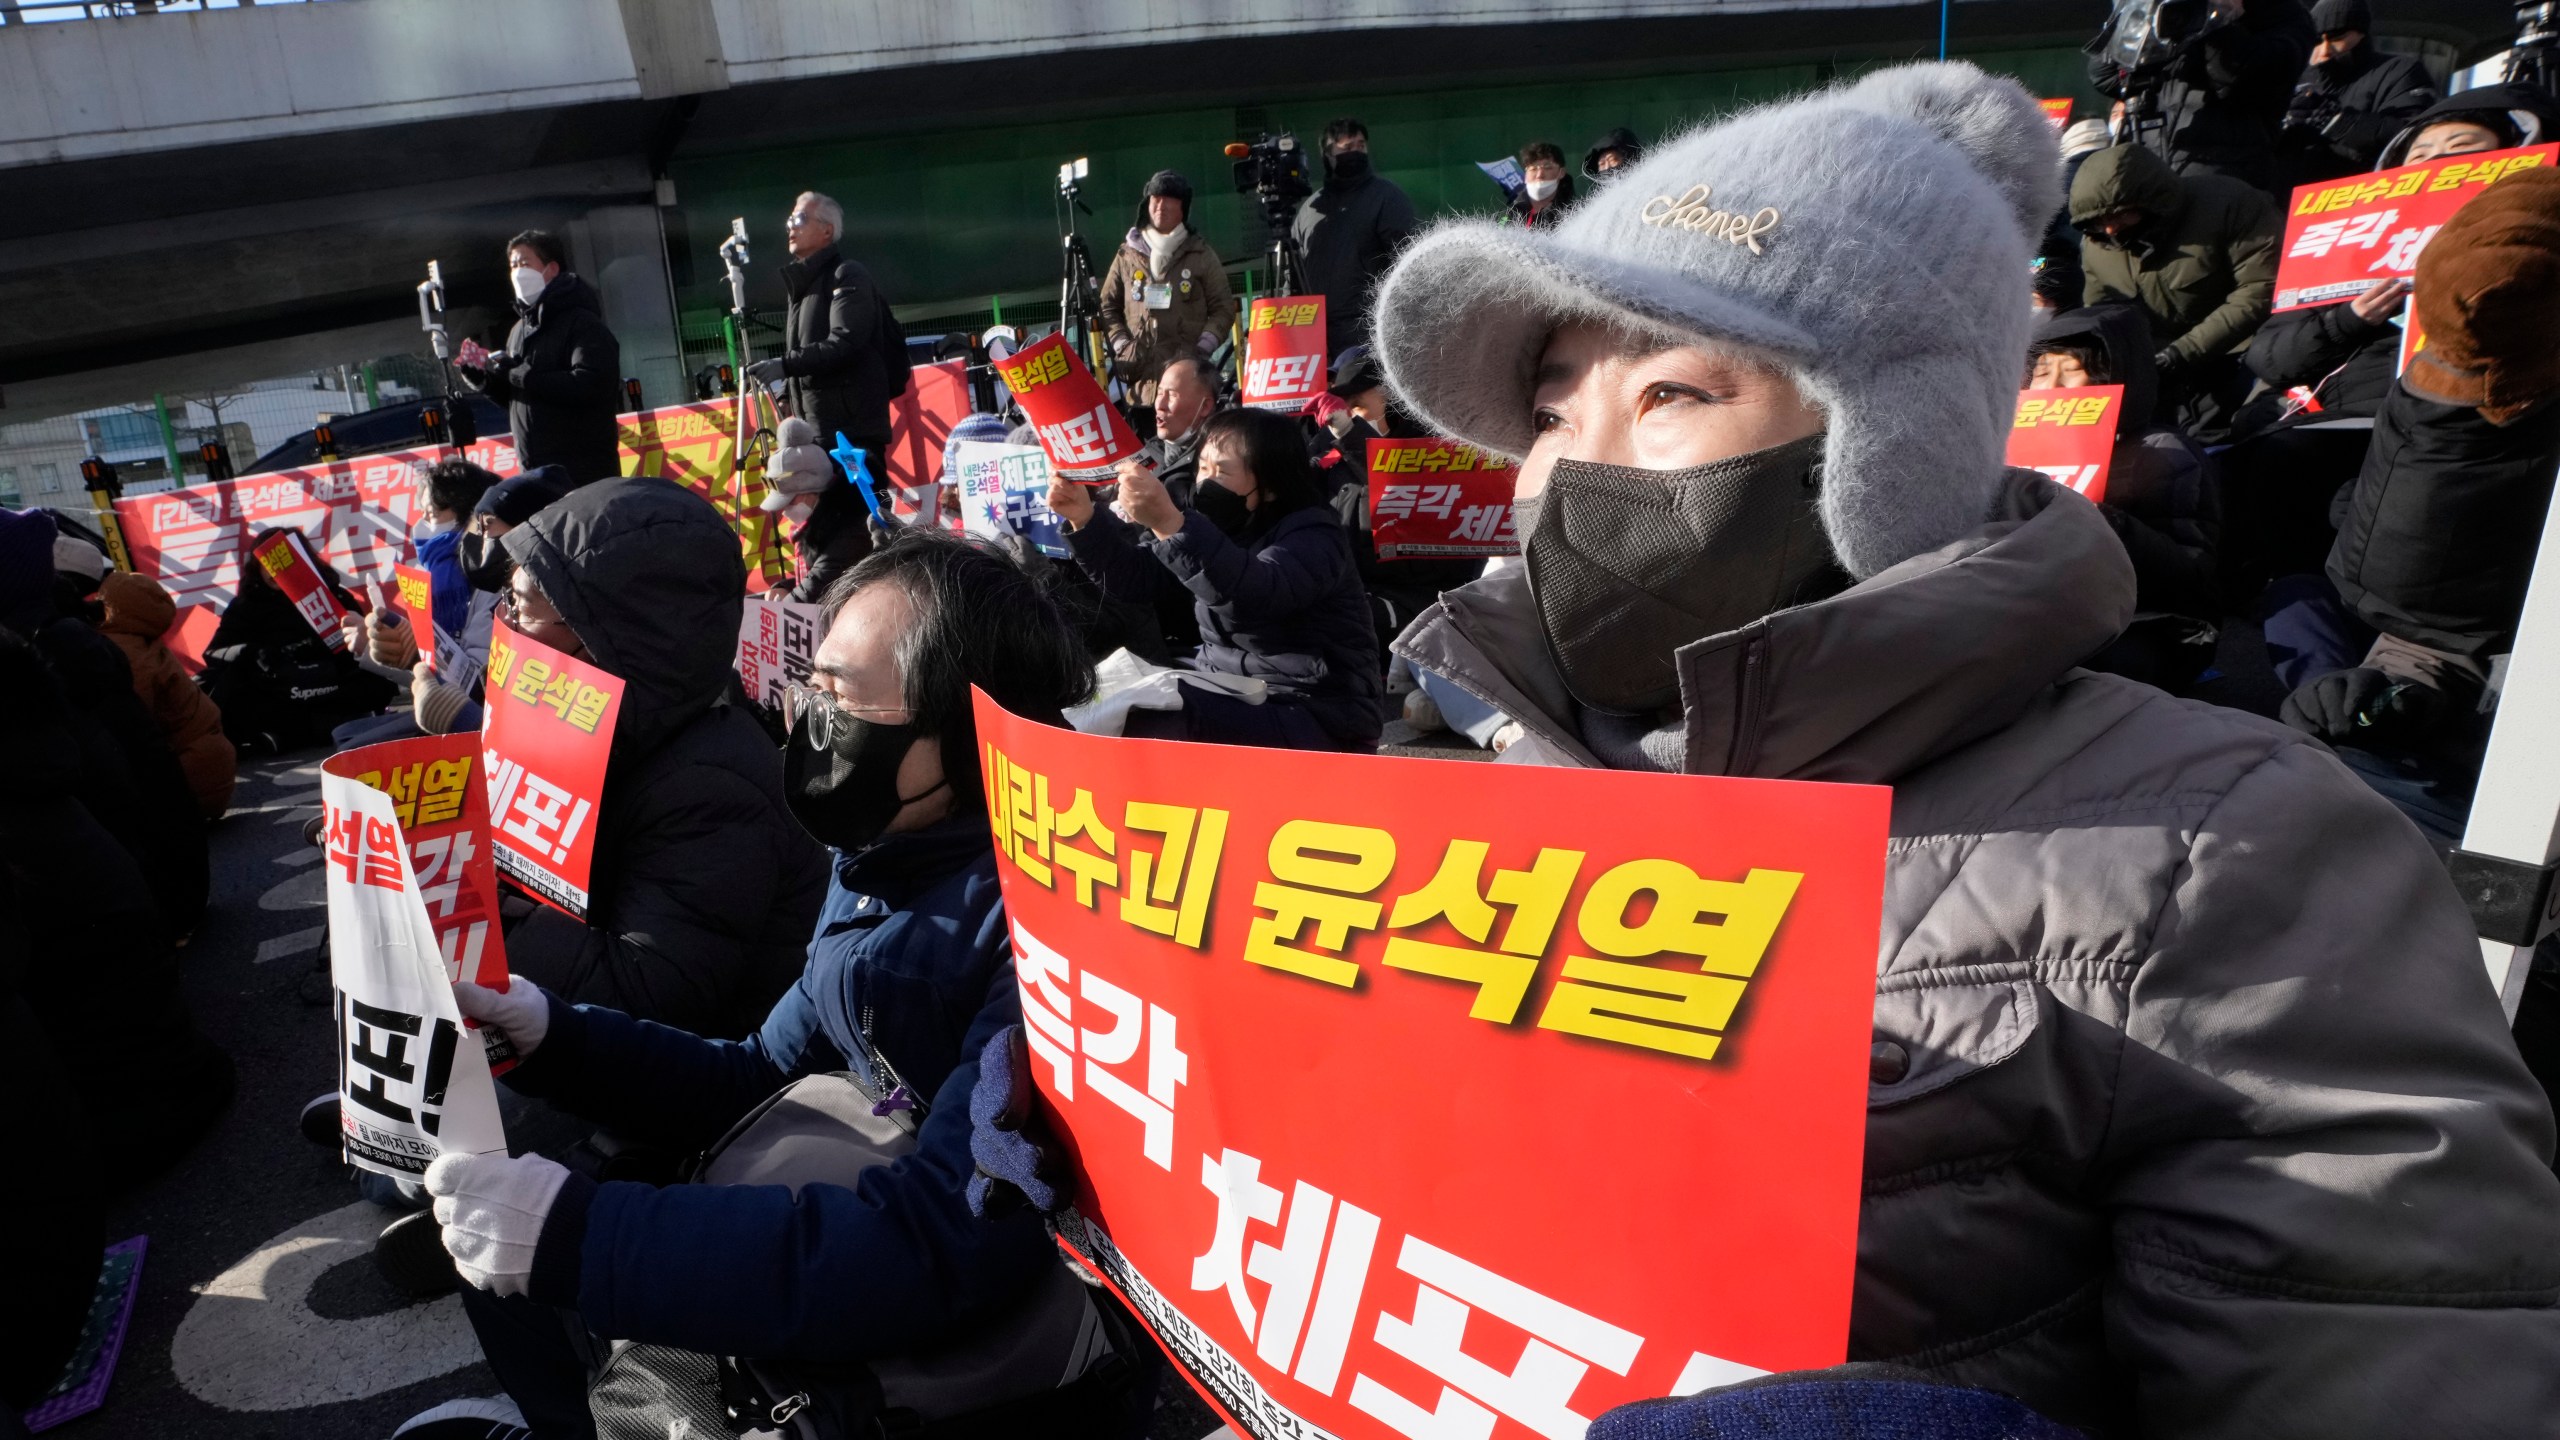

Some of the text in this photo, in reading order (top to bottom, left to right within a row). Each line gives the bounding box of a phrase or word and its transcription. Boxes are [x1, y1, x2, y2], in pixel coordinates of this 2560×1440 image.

[2293, 169, 2431, 217] 내란수괴
[2288, 208, 2399, 259] 즉각
[1256, 303, 1319, 331] 윤석열
[1010, 344, 1070, 394] 윤석열
[1245, 354, 1322, 397] 체포!
[1040, 403, 1117, 464] 체포!
[2013, 396, 2111, 428] 윤석열
[963, 459, 998, 479] 내란수괴
[966, 475, 1001, 497] 윤석열
[229, 479, 304, 518] 윤석열
[309, 470, 360, 501] 체포
[1376, 485, 1462, 519] 즉각
[298, 586, 340, 634] 포!
[760, 606, 778, 667] 김건희
[511, 657, 611, 735] 윤석열
[483, 748, 591, 867] 체포!
[322, 799, 404, 893] 석열
[537, 868, 561, 890] 모이자!
[986, 741, 1804, 1061] 내란수괴 윤석열
[336, 984, 458, 1138] 포!
[1012, 916, 1188, 1173] 즉각
[358, 1122, 372, 1142] 될
[370, 1129, 407, 1154] 때까지
[1131, 1268, 1161, 1317] 즉각
[1161, 1300, 1202, 1354] 체포!
[1204, 1339, 1258, 1411] 김건희
